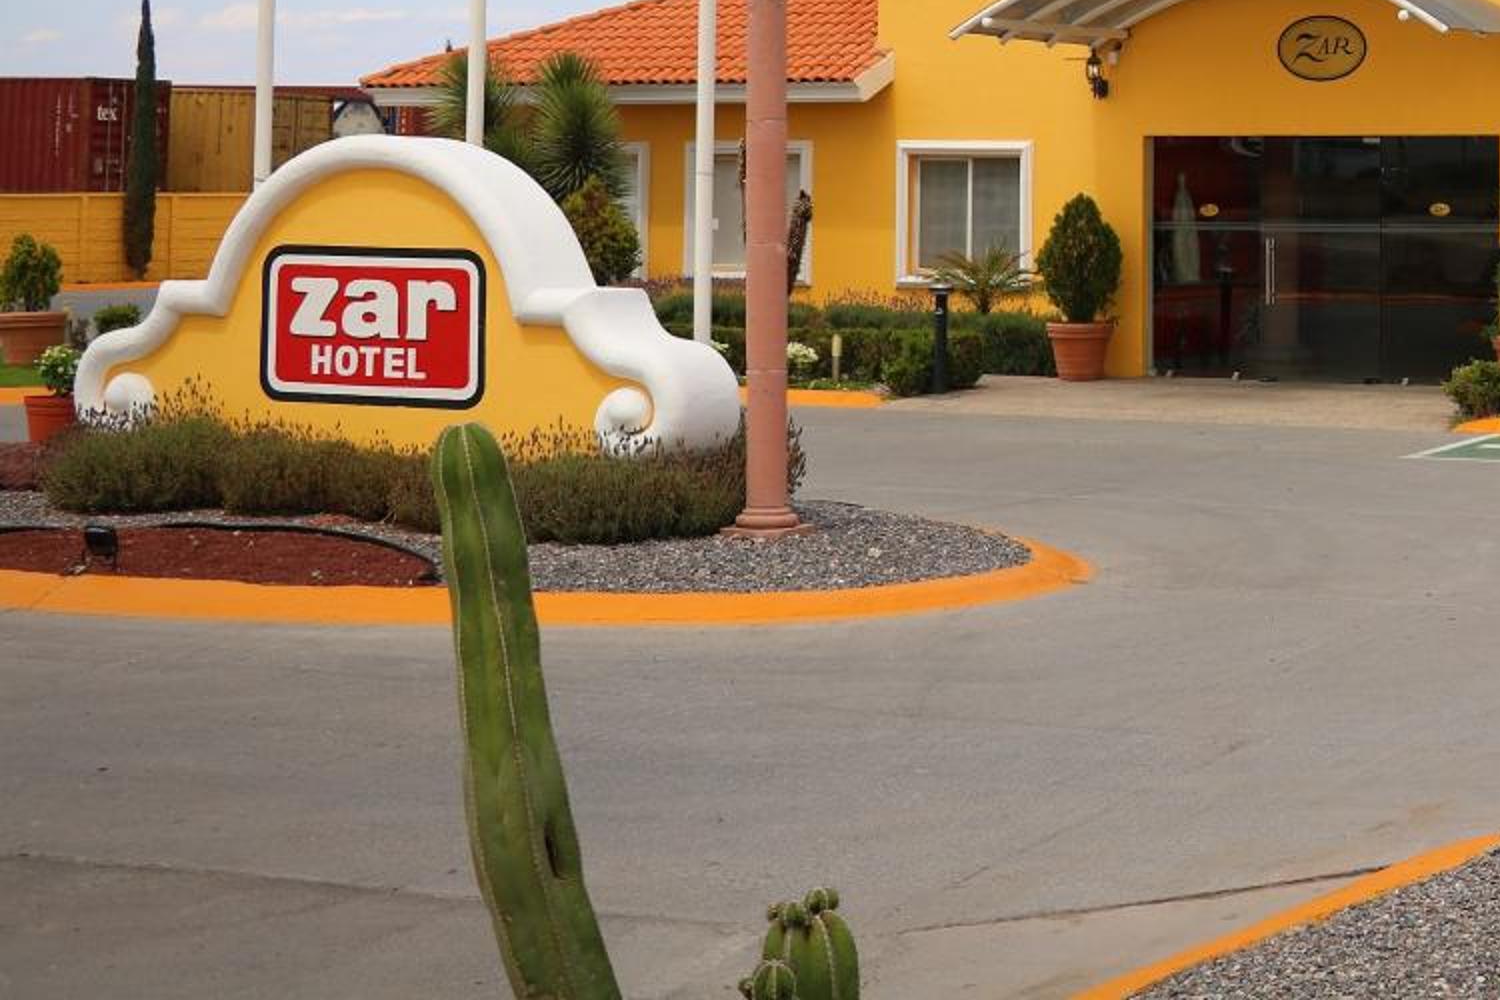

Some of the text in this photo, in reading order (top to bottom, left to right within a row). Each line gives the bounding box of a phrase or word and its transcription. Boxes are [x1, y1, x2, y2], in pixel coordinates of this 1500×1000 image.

[1294, 33, 1354, 63] ZAR
[289, 276, 457, 341] zar
[310, 343, 427, 380] HOTEL
